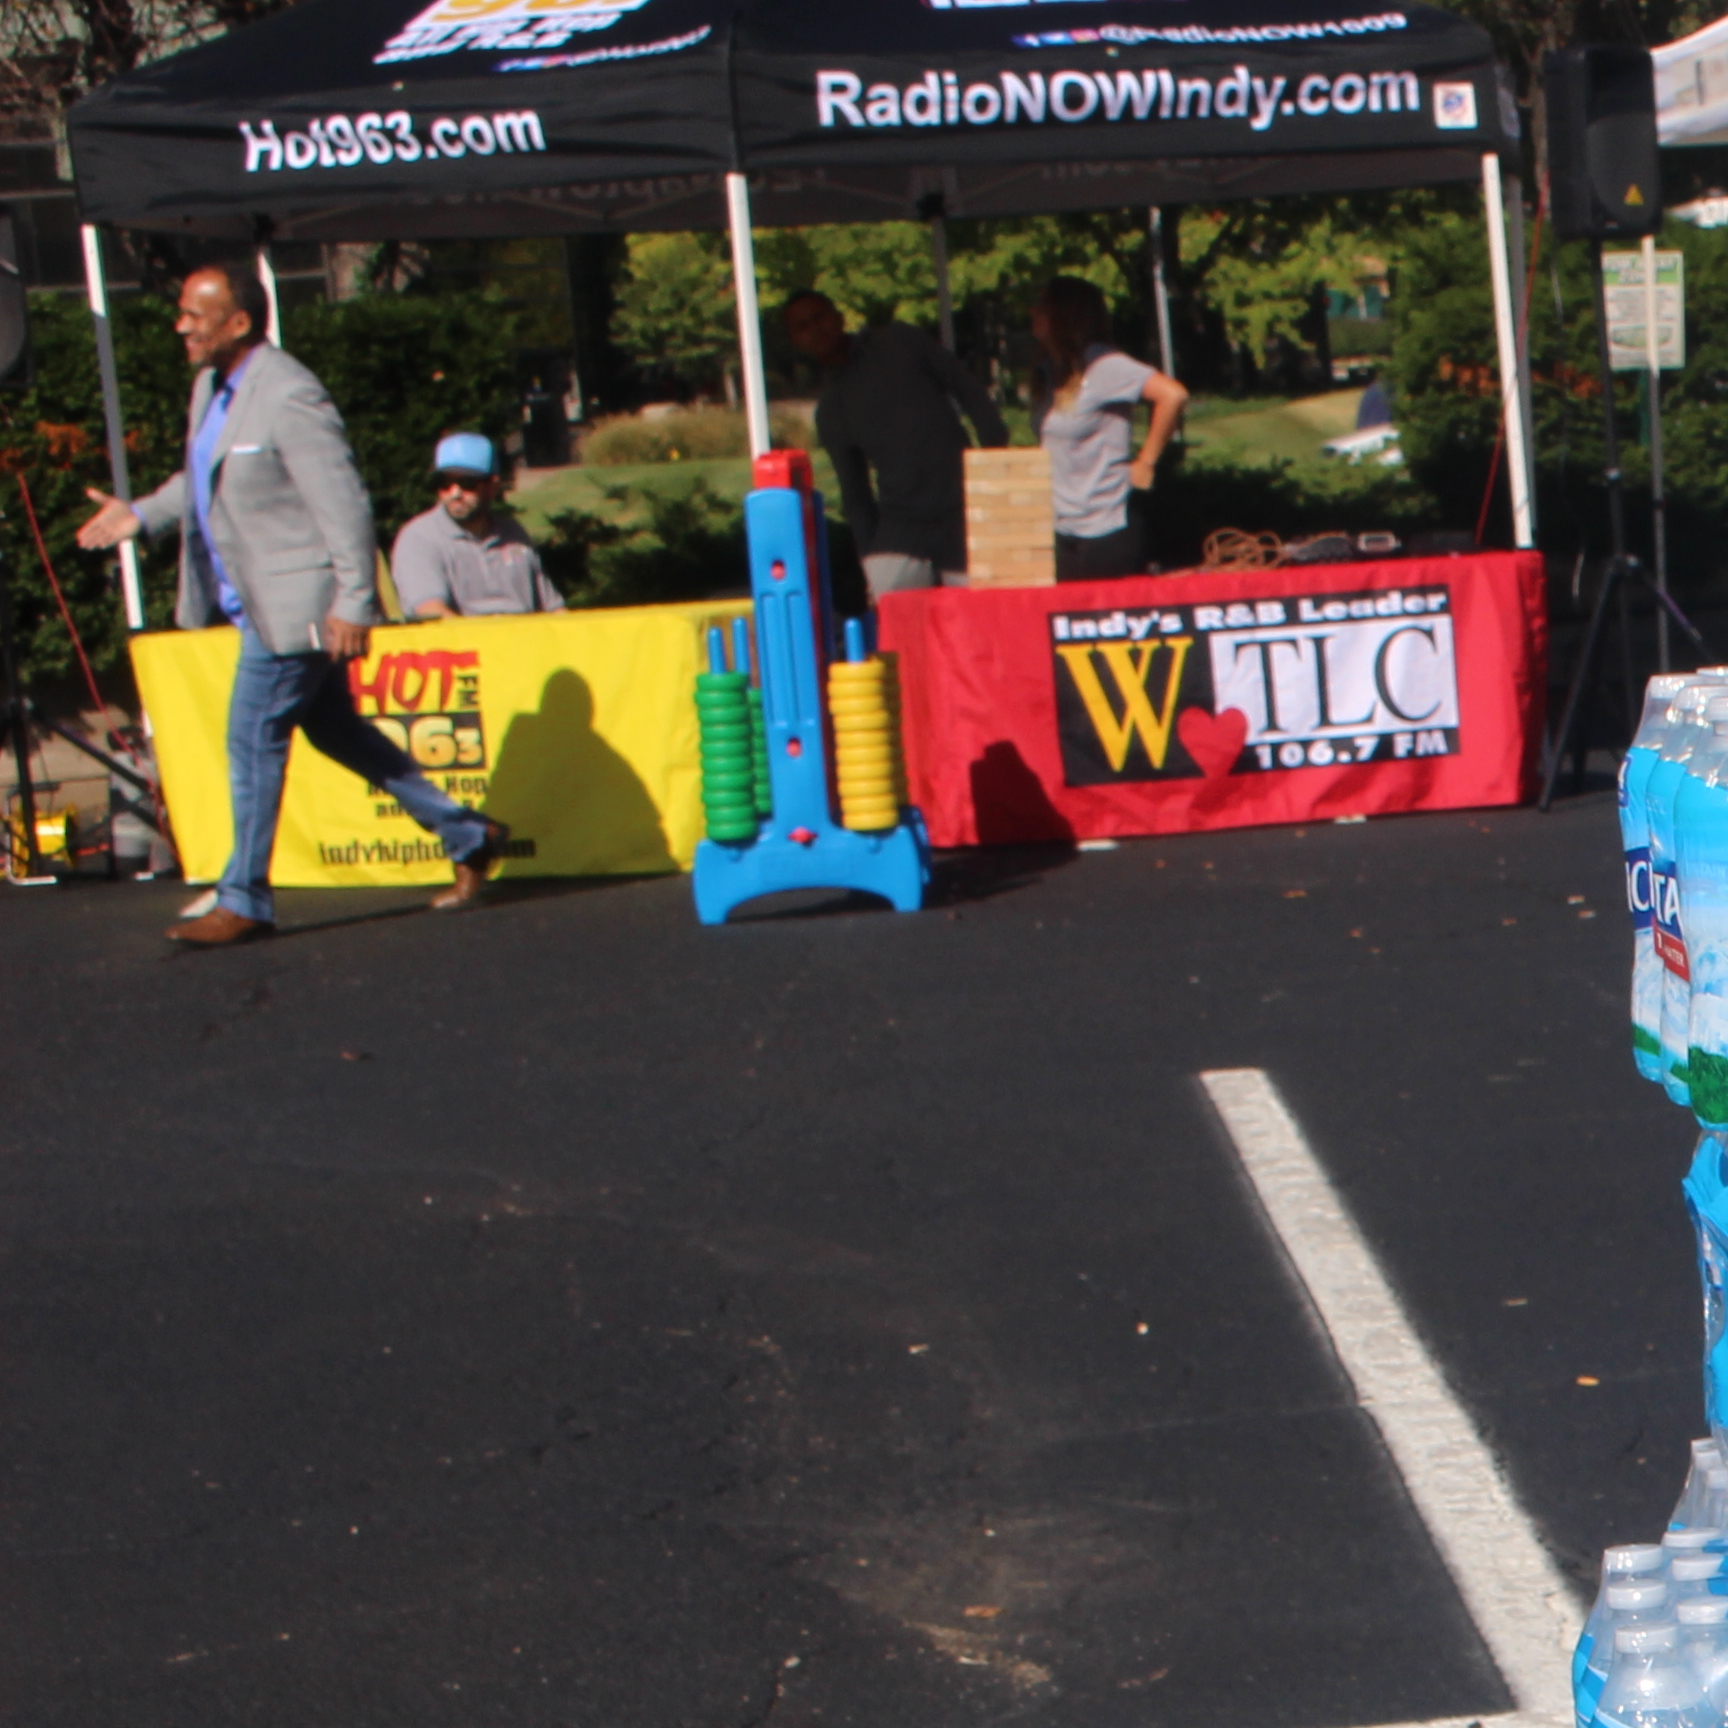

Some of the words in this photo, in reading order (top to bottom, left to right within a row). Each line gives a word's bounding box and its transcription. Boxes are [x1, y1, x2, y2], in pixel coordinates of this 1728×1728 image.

[815, 66, 1420, 131] RadioNOWIndy.com
[241, 110, 547, 173] Hot963.com
[1053, 609, 1183, 641] Indy's
[1193, 601, 1286, 631] R&B
[1300, 590, 1448, 622] Leader
[348, 650, 480, 716] HOT
[457, 675, 479, 710] FM
[1055, 636, 1194, 773] W
[1234, 623, 1441, 737] TLC
[1254, 735, 1378, 770] 106.7
[1394, 730, 1448, 758] FM
